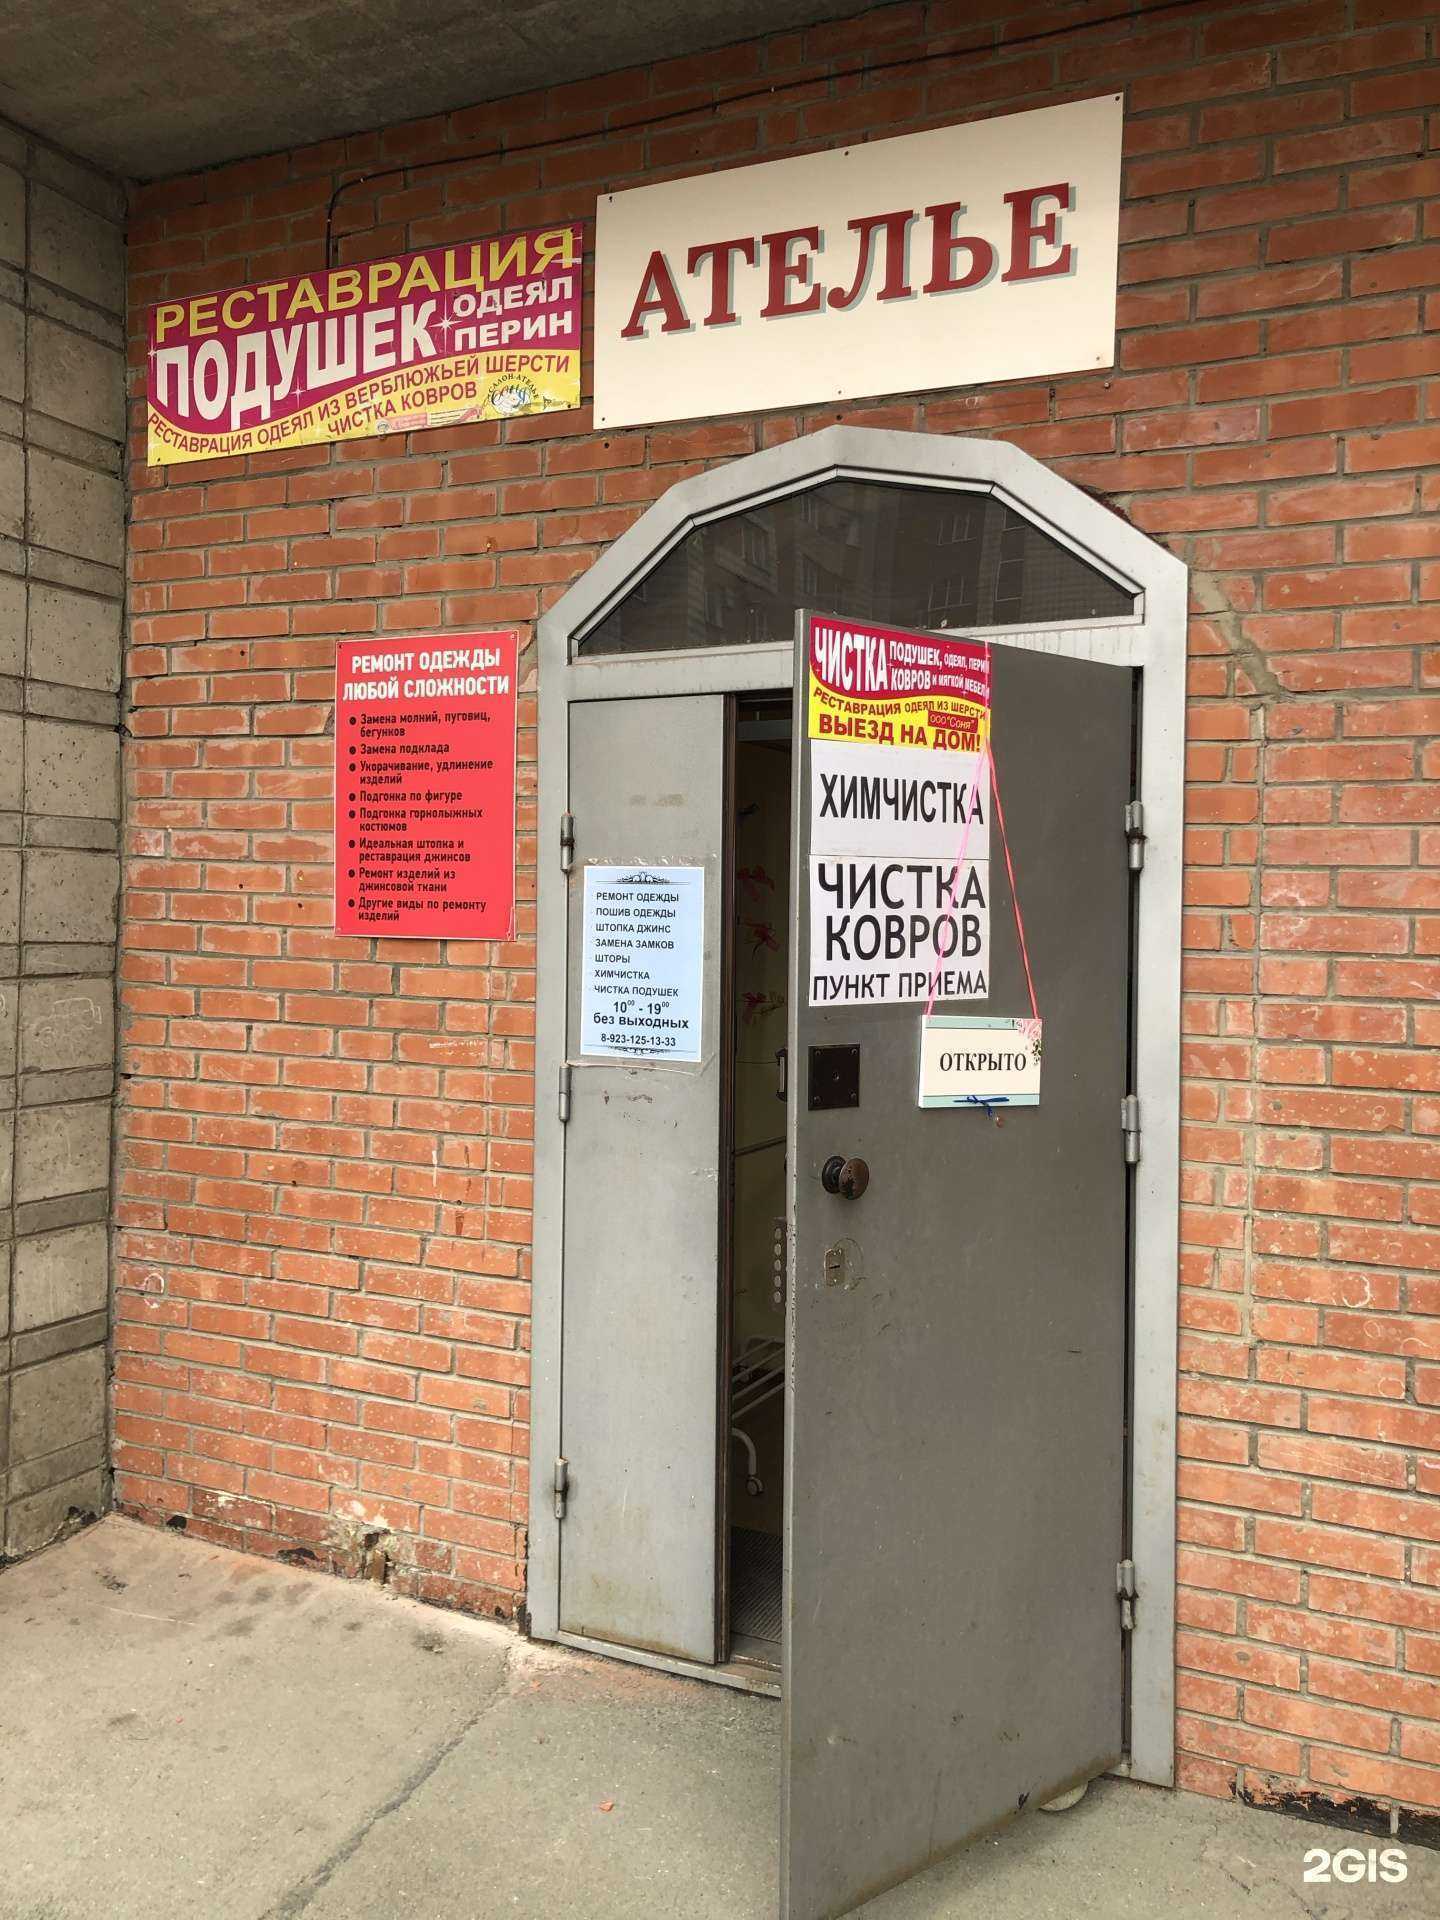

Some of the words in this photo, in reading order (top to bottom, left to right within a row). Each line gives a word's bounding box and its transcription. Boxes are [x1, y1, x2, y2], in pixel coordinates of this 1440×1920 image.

[621, 182, 1078, 341] АТЕЛЬЕ
[155, 228, 574, 343] РЕСТАВРАЦИЯ
[453, 276, 573, 318] ОДЕЯЛ
[454, 311, 573, 351] ПЕРИН
[155, 299, 437, 431] ПОДУШЕК
[148, 413, 252, 454] РЕСТАВРАЦИЯ
[258, 413, 313, 445] ОДЕЯЛ
[319, 400, 341, 421] ИЗ
[346, 356, 479, 411] ВЕРБЛЮЖЬЕЙ
[486, 355, 569, 373] ШЕРСТИ
[328, 402, 396, 436] ЧИСТКА
[402, 381, 477, 410] КОВРОВ
[351, 652, 415, 674] РЕМОНТ
[419, 648, 500, 673] ОДЕЖДЫ
[815, 626, 888, 692] ЧИСТКА
[890, 640, 943, 669] ПОДУШЕК,
[891, 667, 931, 691] КОВРОВ
[939, 674, 964, 688] МЯГКОЙ
[342, 676, 399, 701] ЛЮБОЙ
[404, 675, 509, 698] СЛОЖНОСТИ
[813, 687, 900, 717] РЕСТАВРАЦИЯ
[905, 701, 935, 713] ОДЕЯЛ
[937, 701, 949, 710] ИЗ
[360, 713, 397, 725] Замена
[400, 711, 441, 725] молний,
[445, 711, 491, 726] пуговиц,
[360, 727, 405, 740] бегунков
[819, 714, 894, 745] ВЫЕЗД
[901, 724, 928, 745] НА
[933, 729, 980, 752] ДОМ!
[360, 743, 396, 755] Замена
[400, 743, 450, 755] подклада
[360, 760, 434, 774] Укорачивание,
[437, 760, 494, 772] удлинение
[360, 773, 402, 785] изделий
[360, 790, 406, 802] Подгонка
[410, 792, 421, 800] по
[425, 790, 462, 803] фигуре
[819, 773, 983, 825] ХИМЧИСТКА
[360, 807, 406, 819] Подгонка
[410, 808, 483, 821] горнолыжных
[360, 821, 407, 832] костюмов
[359, 837, 413, 850] Идеальная
[416, 839, 454, 849] штопка
[457, 839, 464, 848] и
[359, 852, 420, 864] реставрация
[424, 852, 471, 863] джинсов
[359, 866, 393, 878] Ремонт
[397, 868, 440, 880] изделий
[444, 869, 456, 879] из
[359, 879, 414, 892] джинсовой
[417, 882, 447, 892] ткани
[818, 863, 986, 909] ЧИСТКА
[358, 896, 393, 910] Другие
[397, 900, 424, 909] виды
[427, 901, 439, 909] по
[442, 901, 487, 912] ремонту
[596, 891, 634, 901] РЕМОНТ
[636, 893, 679, 903] ОДЕЖДЫ
[358, 910, 400, 921] изделий
[596, 907, 631, 917] ПОШИВ
[633, 908, 676, 918] ОДЕЖДЫ
[595, 923, 634, 933] ШТОПКА
[636, 924, 671, 934] ДЖИНС
[595, 938, 633, 948] ЗАМЕНА
[635, 939, 674, 949] ЗАМКОВ
[826, 913, 982, 962] КОВРОВ
[594, 954, 630, 964] ШТОРЫ
[594, 969, 650, 979] ХИМЧИСТКА
[594, 985, 629, 995] ЧИСТКА
[632, 986, 679, 997] ПОДУШЕК
[813, 973, 890, 1001] ПУНКТ
[898, 970, 987, 997] ПРИЕМА
[593, 1012, 615, 1025] без
[619, 1015, 689, 1029] выходных
[600, 1033, 676, 1047] 8-923-125-13-33
[939, 1051, 1027, 1073] ОТКРЫТО
